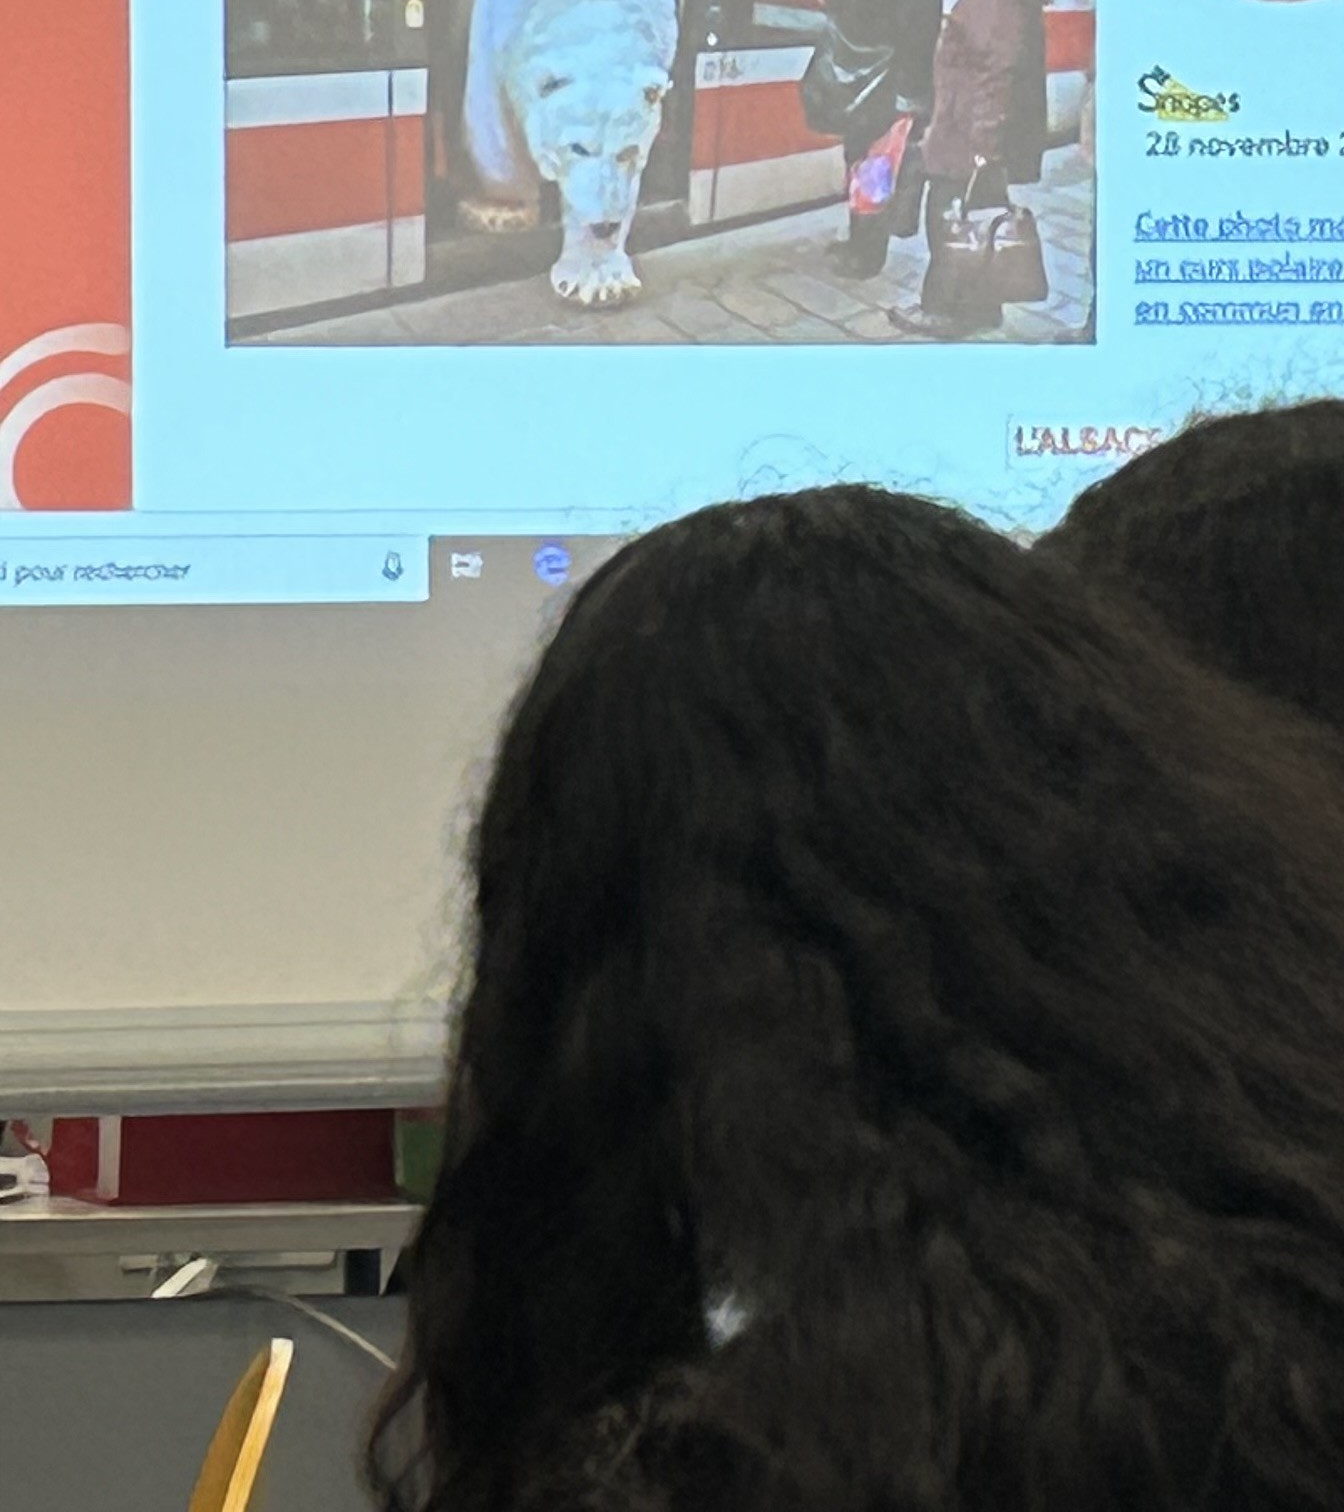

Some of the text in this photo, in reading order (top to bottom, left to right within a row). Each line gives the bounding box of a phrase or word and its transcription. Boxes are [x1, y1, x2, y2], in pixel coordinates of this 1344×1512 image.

[1188, 129, 1330, 158] novembre
[1135, 211, 1209, 239] Cette
[1217, 210, 1299, 242] photo
[1135, 260, 1171, 280] un
[1247, 251, 1344, 283] polaire
[1135, 300, 1171, 321] en
[1309, 300, 1344, 322] en
